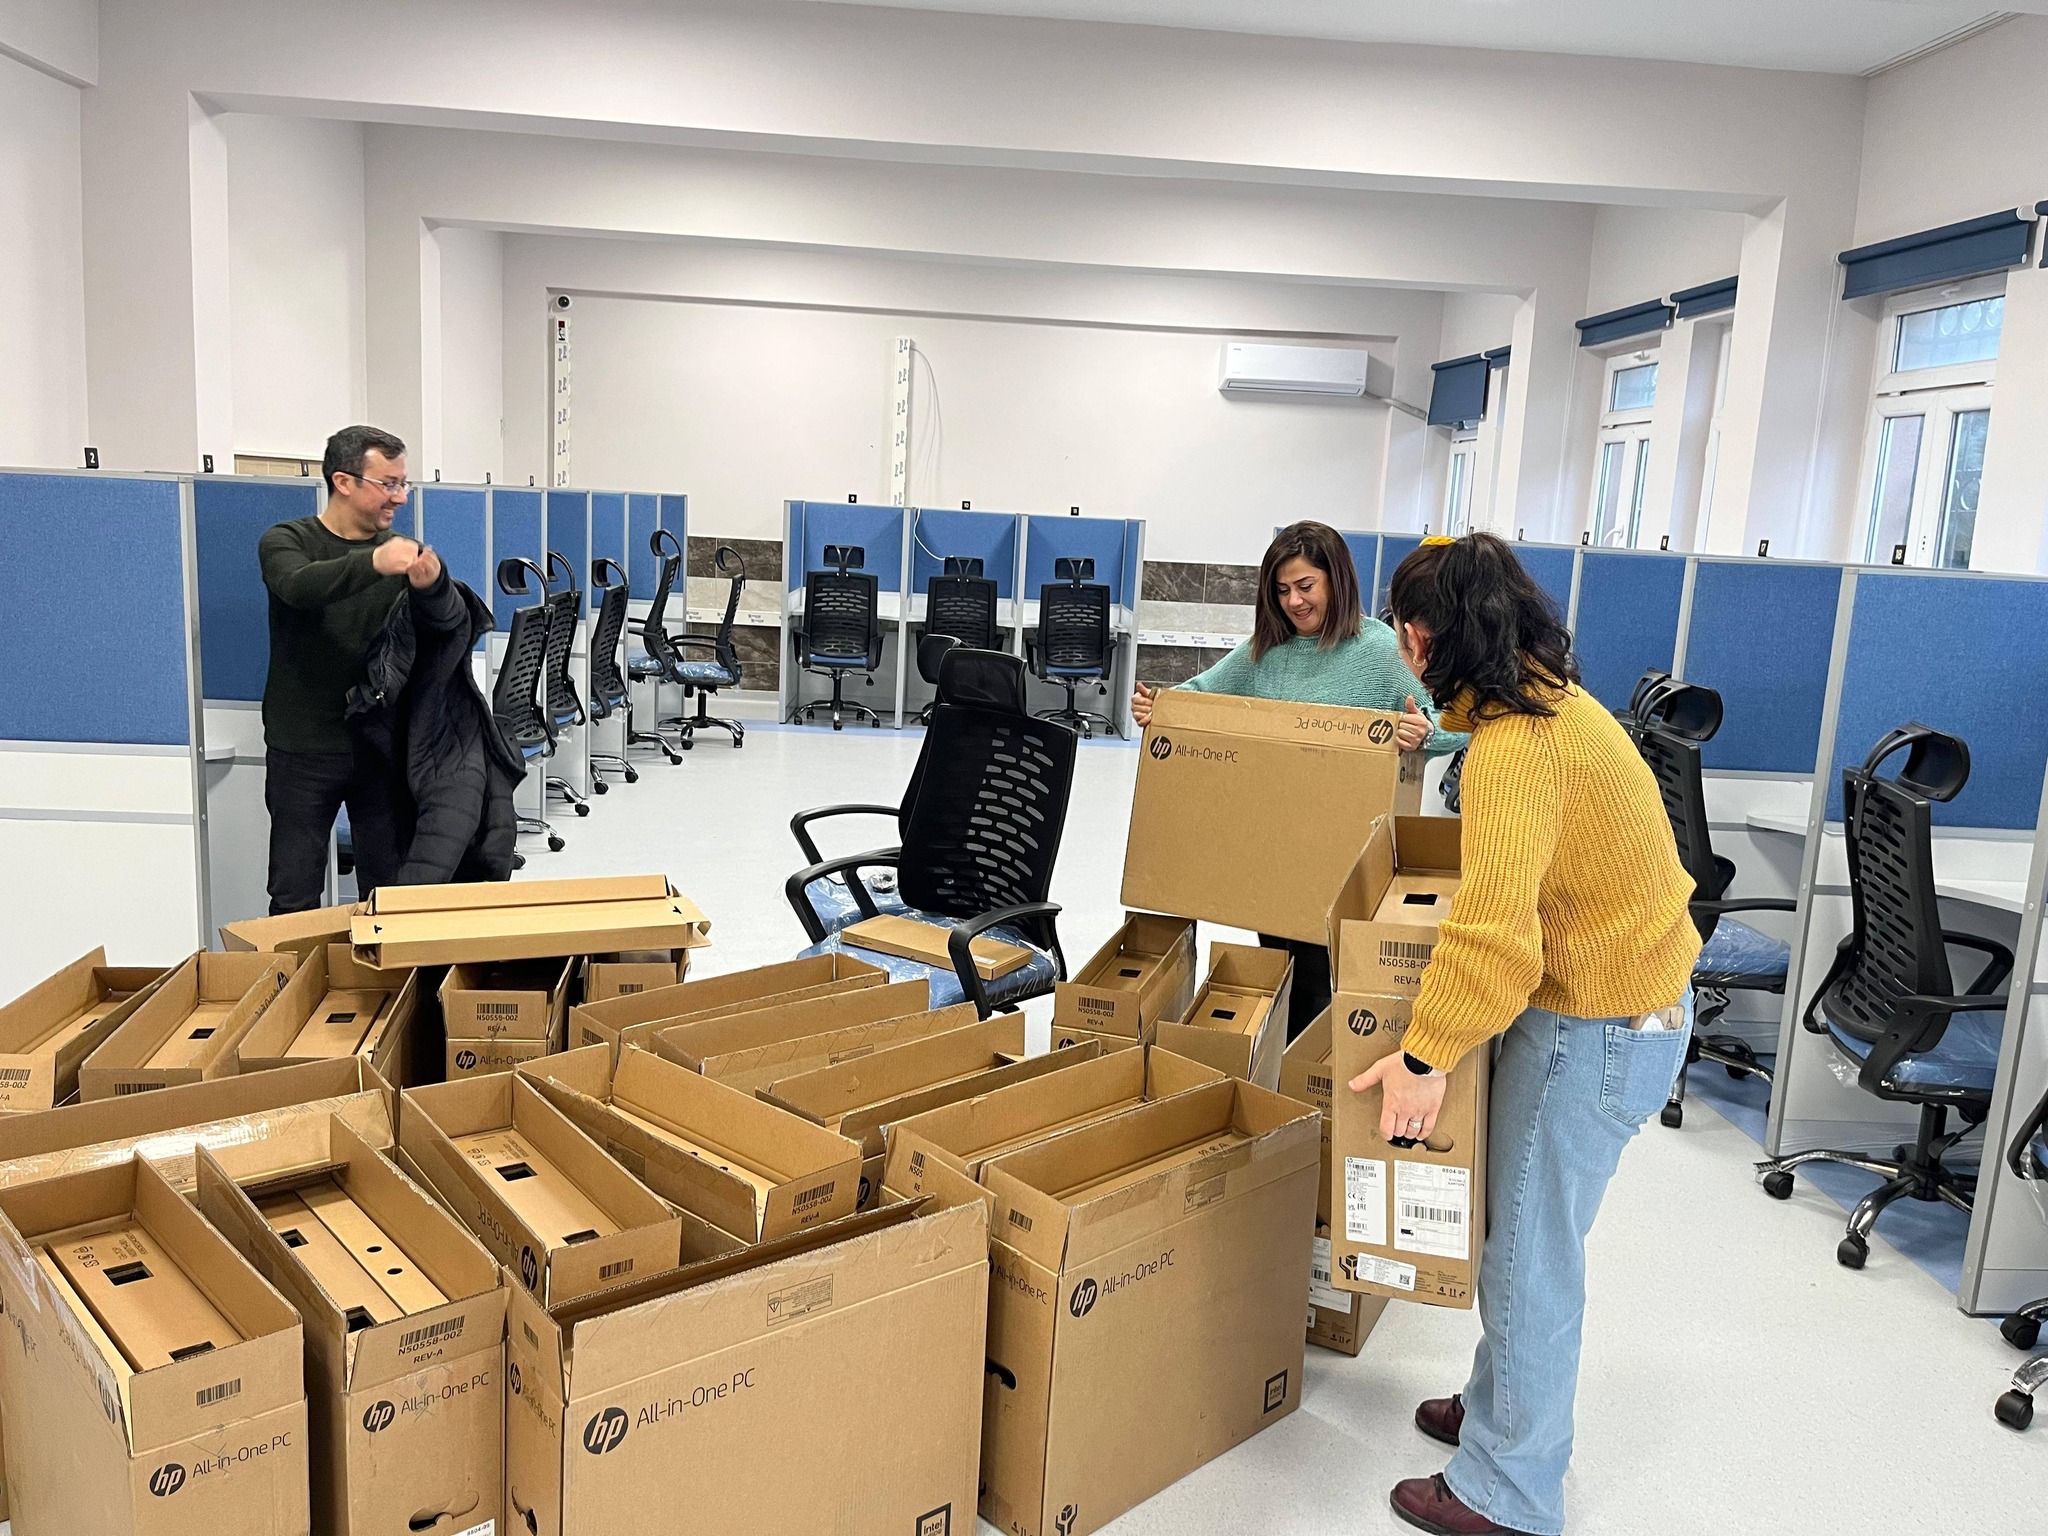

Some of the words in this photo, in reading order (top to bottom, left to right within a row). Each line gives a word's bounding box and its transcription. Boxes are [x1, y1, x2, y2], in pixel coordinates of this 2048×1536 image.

[89, 452, 96, 464] 2
[206, 458, 212, 469] 3
[1295, 717, 1309, 729] PC
[1311, 719, 1364, 736] All-in-One
[1368, 718, 1394, 745] hp
[1150, 735, 1172, 760] hp
[1174, 744, 1223, 762] All-in-One
[1224, 750, 1239, 763] PC
[1379, 957, 1432, 970] N50558-0
[1394, 975, 1421, 986] REV-A
[1348, 1008, 1377, 1037] hp
[456, 1050, 476, 1070] hp
[521, 1245, 538, 1291] hp
[1036, 1288, 1048, 1305] PC
[1069, 1278, 1098, 1318] hp
[1101, 1260, 1158, 1297] All-in-One
[1159, 1248, 1175, 1270] PC
[398, 1329, 463, 1356] N50558-002
[413, 1348, 444, 1364] REV-A
[510, 1362, 522, 1395] hp
[362, 1400, 396, 1433] hp
[401, 1381, 469, 1415] All-in-One
[471, 1371, 490, 1390] PC
[583, 1406, 629, 1455] hp
[636, 1381, 728, 1429] All-in-One
[732, 1367, 756, 1394] PC
[149, 1463, 187, 1497] hp
[192, 1443, 268, 1479] All-in-One
[272, 1431, 292, 1451] PC
